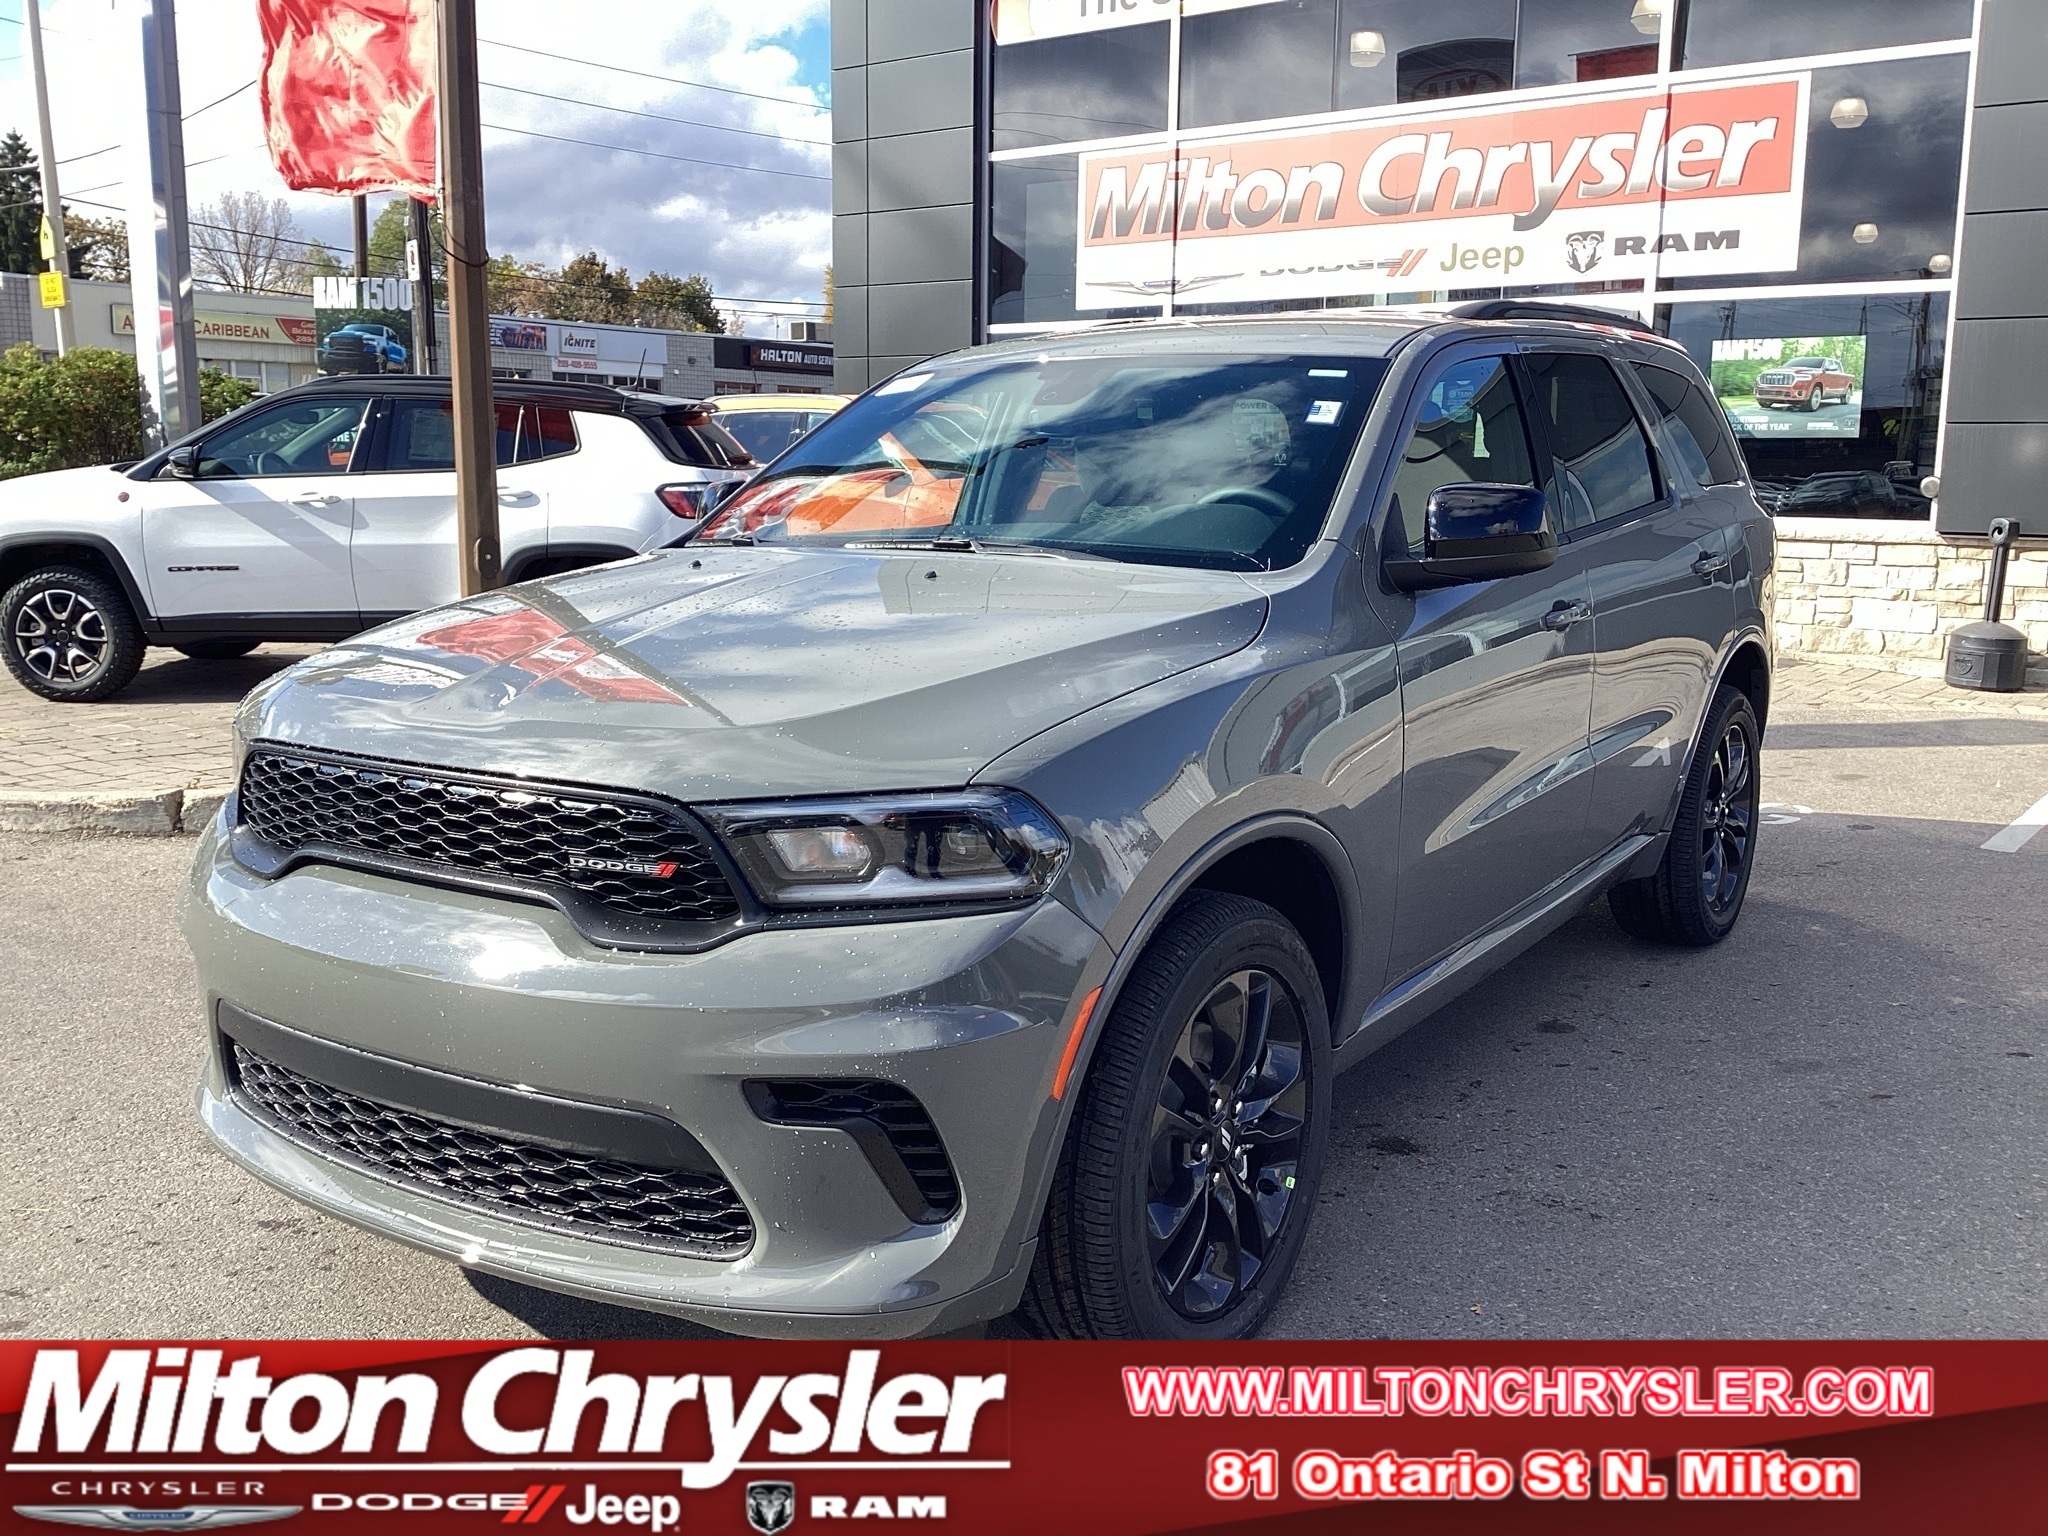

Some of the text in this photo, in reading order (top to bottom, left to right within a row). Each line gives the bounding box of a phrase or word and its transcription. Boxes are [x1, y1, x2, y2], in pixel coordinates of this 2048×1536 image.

[1088, 109, 1778, 240] Milton Chrysler
[1614, 230, 1740, 256] RAM
[1440, 240, 1525, 276] Jeep
[313, 276, 413, 311] RAM 1500
[564, 336, 596, 348] IGNITE
[760, 348, 802, 363] HALTON
[803, 354, 818, 364] AUTO
[569, 856, 661, 874] DODGE
